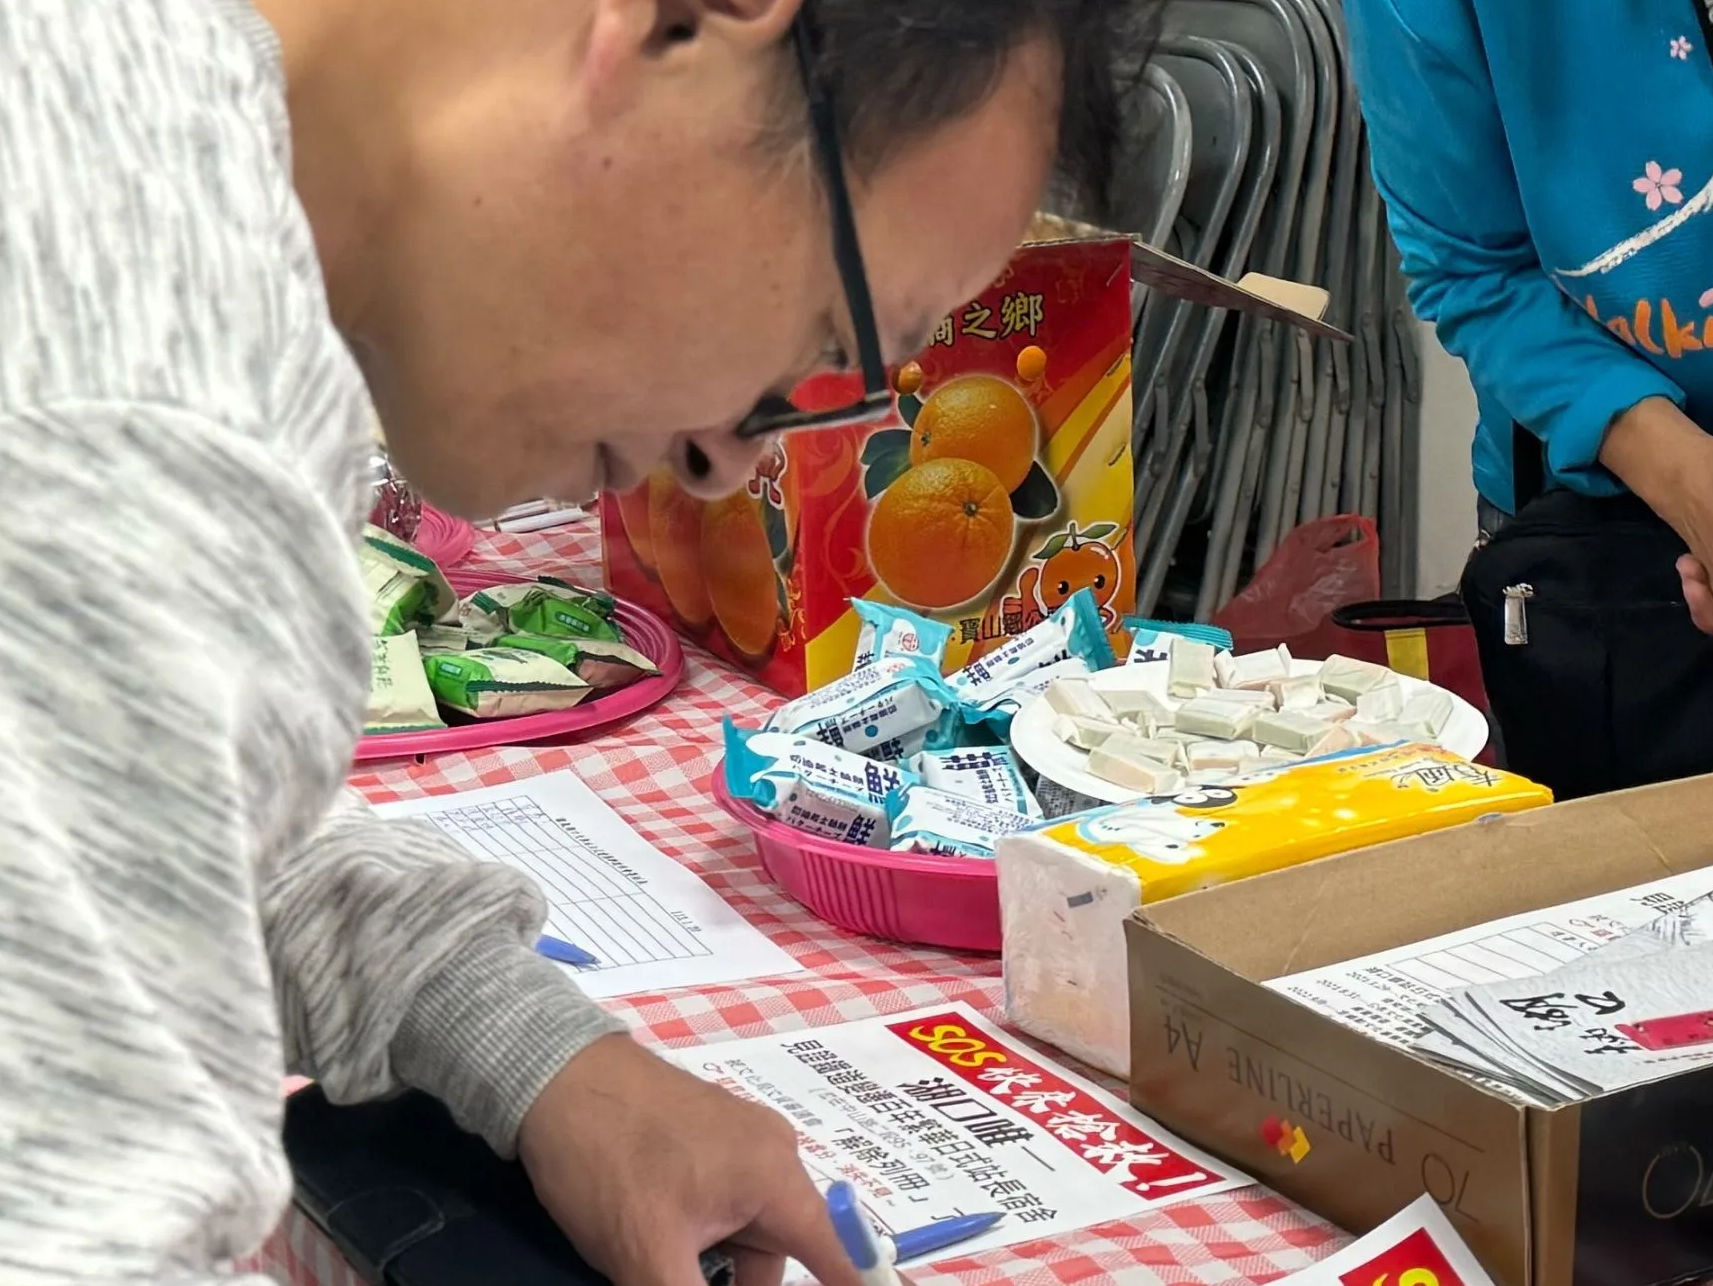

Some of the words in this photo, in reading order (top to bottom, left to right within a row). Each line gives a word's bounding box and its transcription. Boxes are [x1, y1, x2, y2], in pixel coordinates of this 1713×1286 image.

[910, 1024, 1011, 1067] SOS
[1162, 1013, 1204, 1072] A4
[895, 1077, 1055, 1171] 湖口唯一
[1226, 1045, 1397, 1166] PAPERLINE
